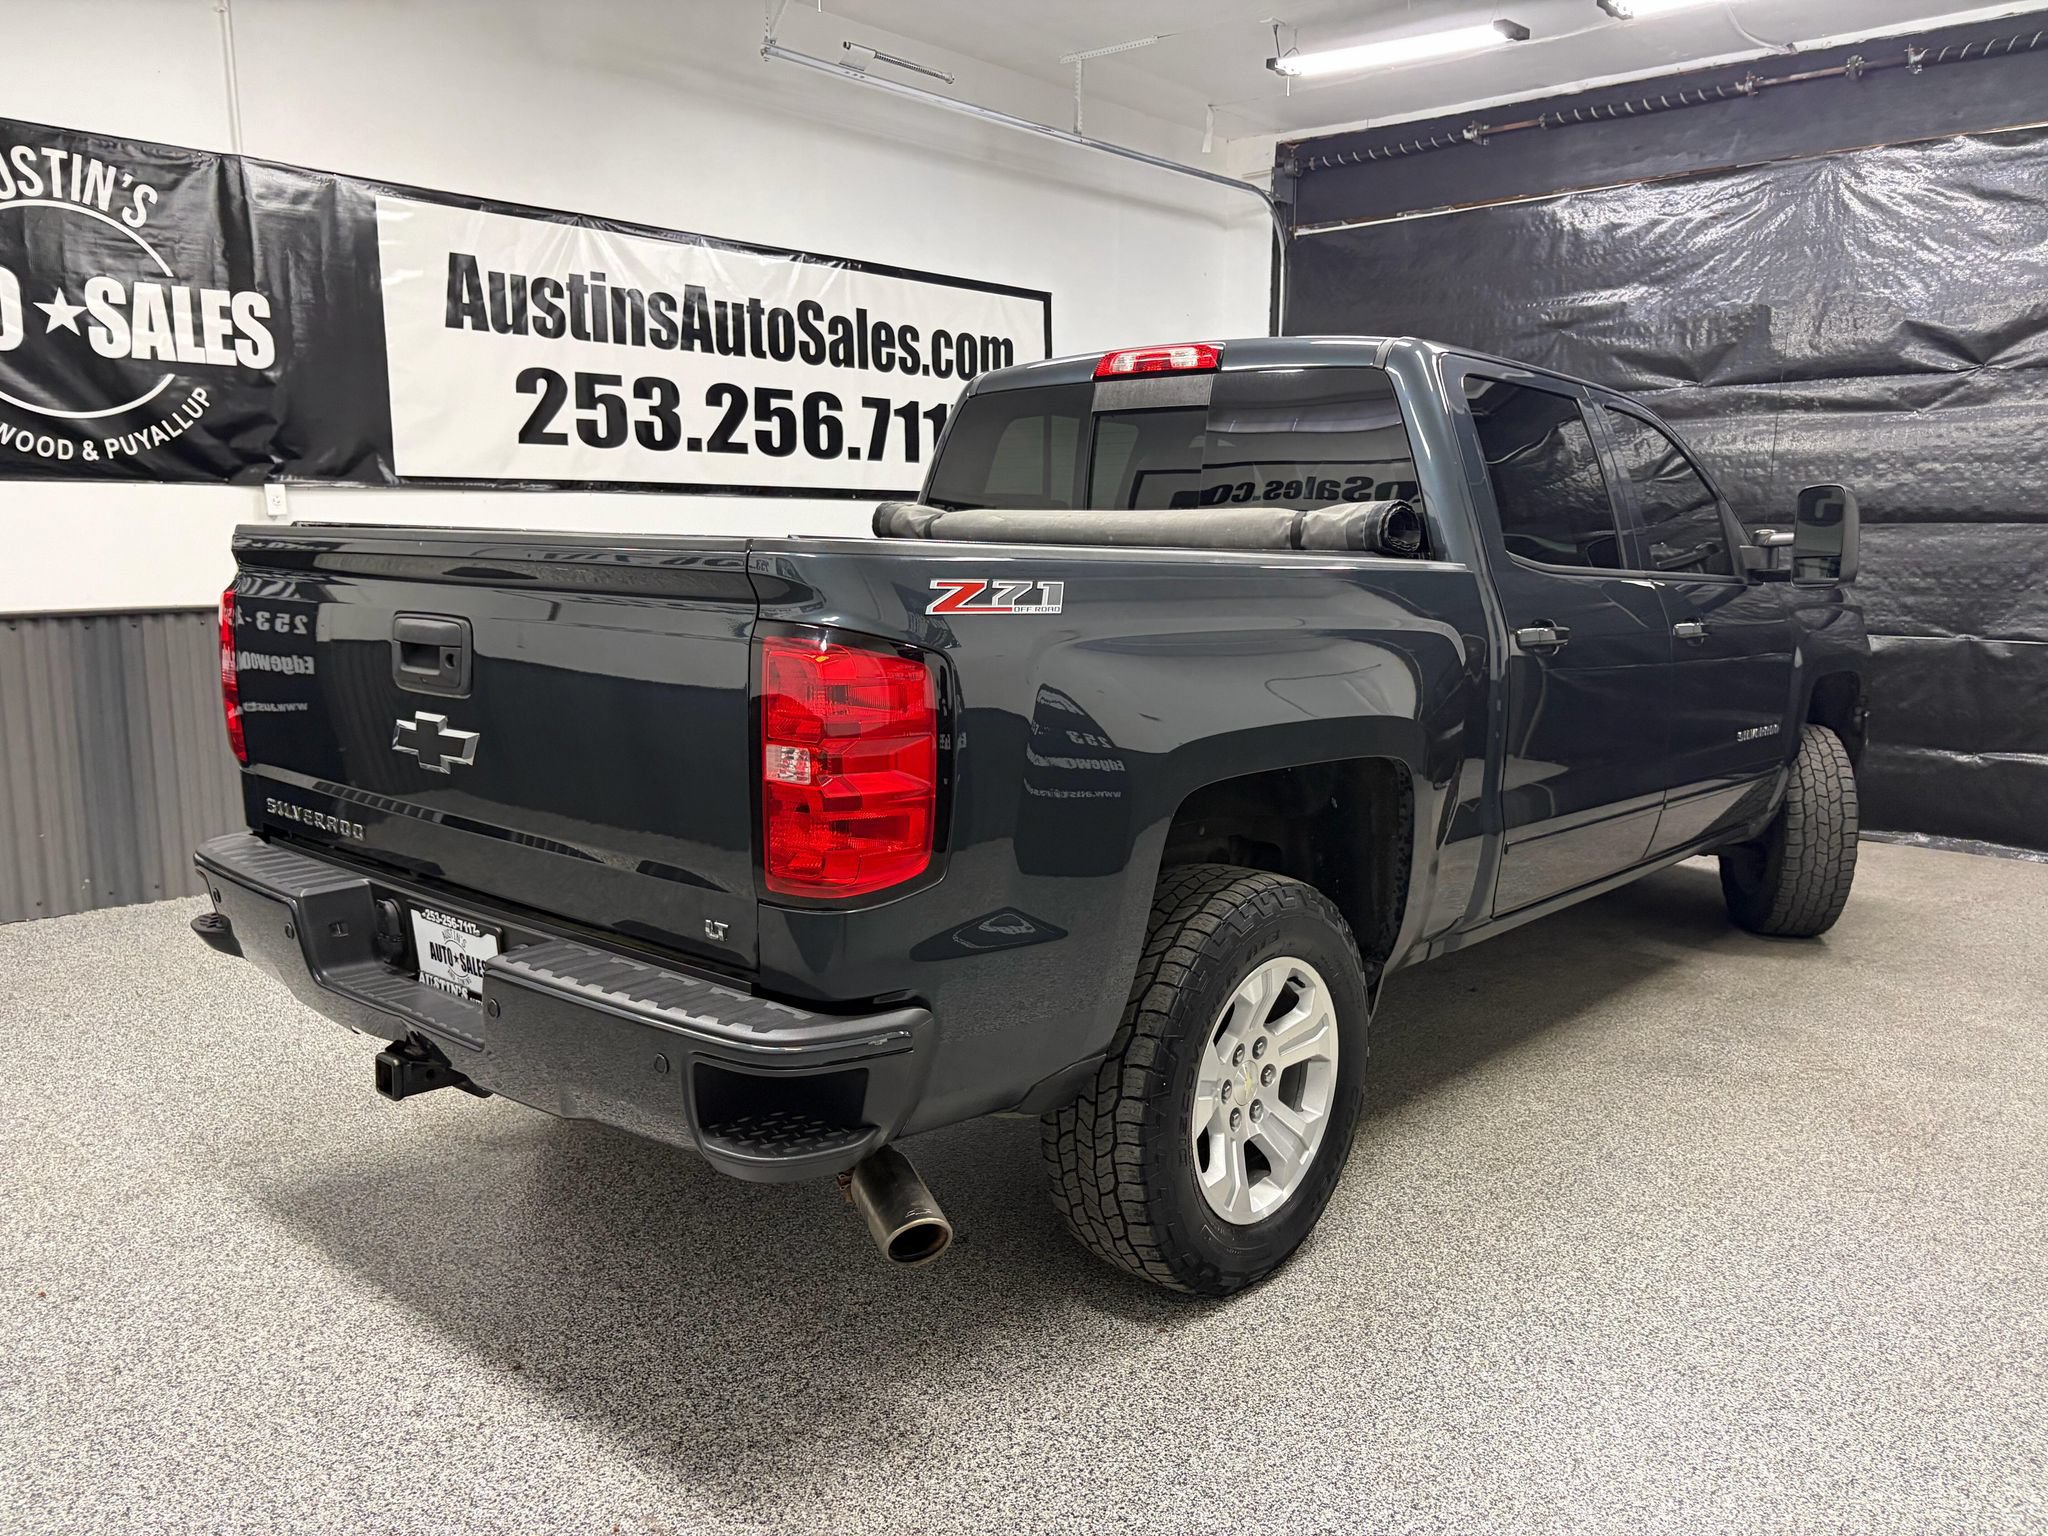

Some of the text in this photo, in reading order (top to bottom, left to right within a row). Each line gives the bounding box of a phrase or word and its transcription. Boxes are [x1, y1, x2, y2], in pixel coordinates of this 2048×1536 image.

[84, 276, 275, 370] SALES
[445, 252, 1013, 382] AustinsAutoSales.com
[82, 440, 100, 462] &
[104, 387, 211, 460] PUYALLUP
[516, 367, 954, 463] 253.256.711
[924, 578, 1065, 615] Z71
[266, 797, 366, 841] SILVERADO
[430, 941, 454, 967] AUTO
[459, 952, 486, 978] SALES
[705, 919, 729, 942] LT
